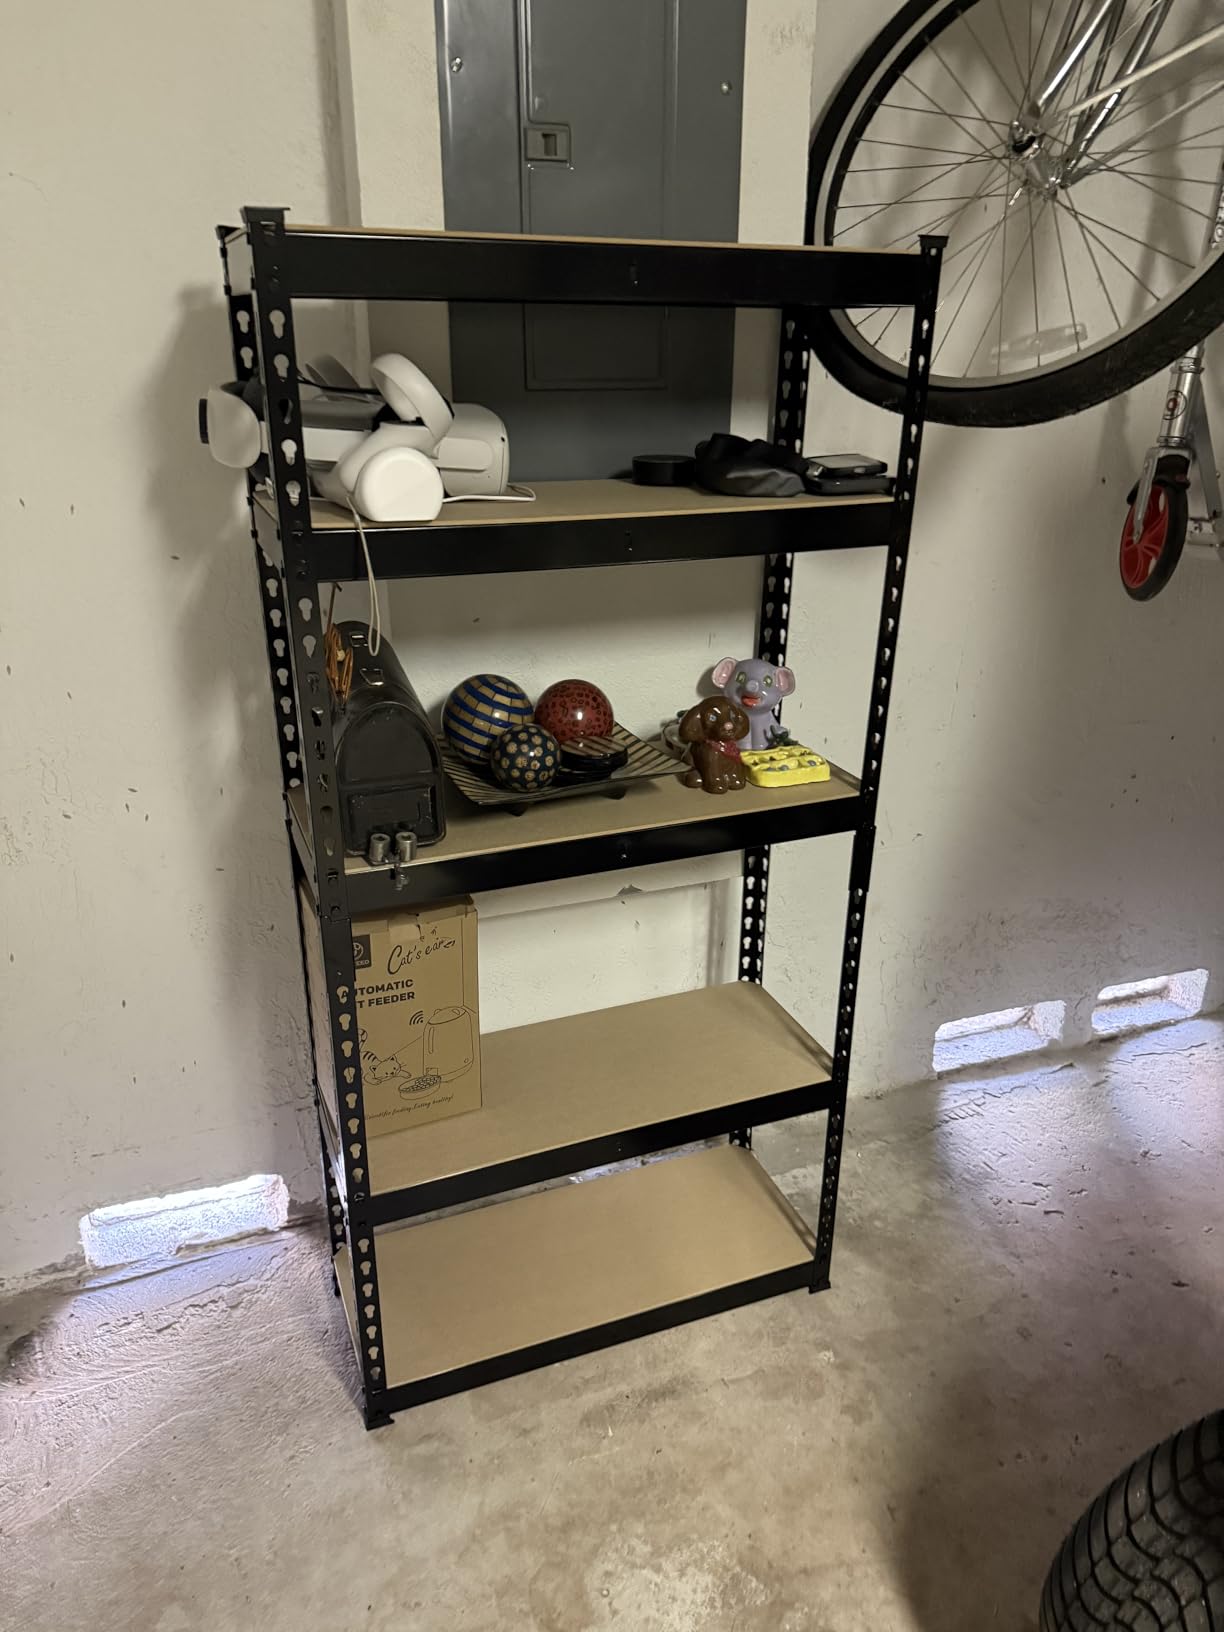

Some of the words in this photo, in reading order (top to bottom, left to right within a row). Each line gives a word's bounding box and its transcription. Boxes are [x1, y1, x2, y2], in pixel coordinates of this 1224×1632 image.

[388, 945, 421, 975] Cat's
[341, 979, 414, 999] ATOMATIC
[368, 992, 415, 1007] FEEDER
